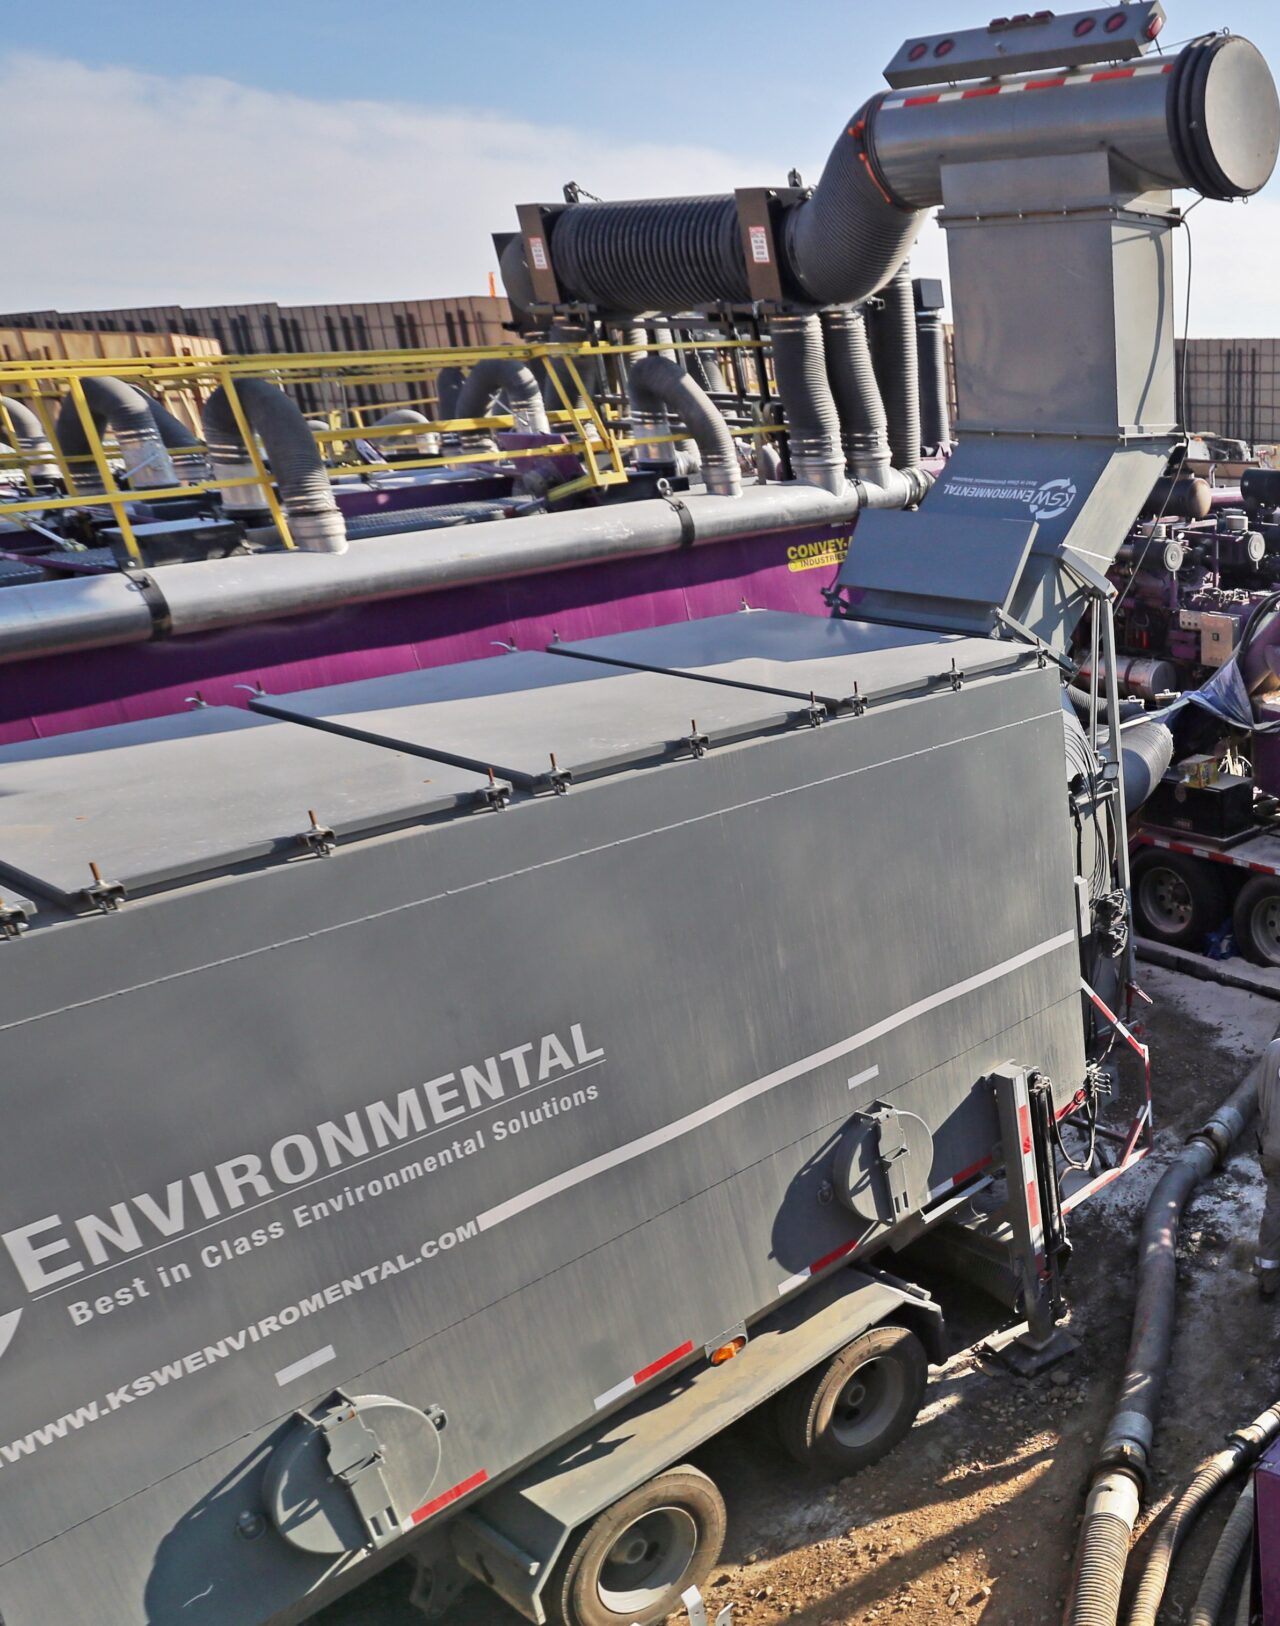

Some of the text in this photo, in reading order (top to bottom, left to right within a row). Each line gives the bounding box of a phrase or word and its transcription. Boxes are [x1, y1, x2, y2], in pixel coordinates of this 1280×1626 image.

[787, 536, 854, 560] CONVEY-
[943, 484, 1075, 508] KSW ENVIRONMENTAL
[2, 1022, 605, 1293] ENVIRONMENTAL
[67, 1085, 599, 1327] Best in Class Environmental Solutions
